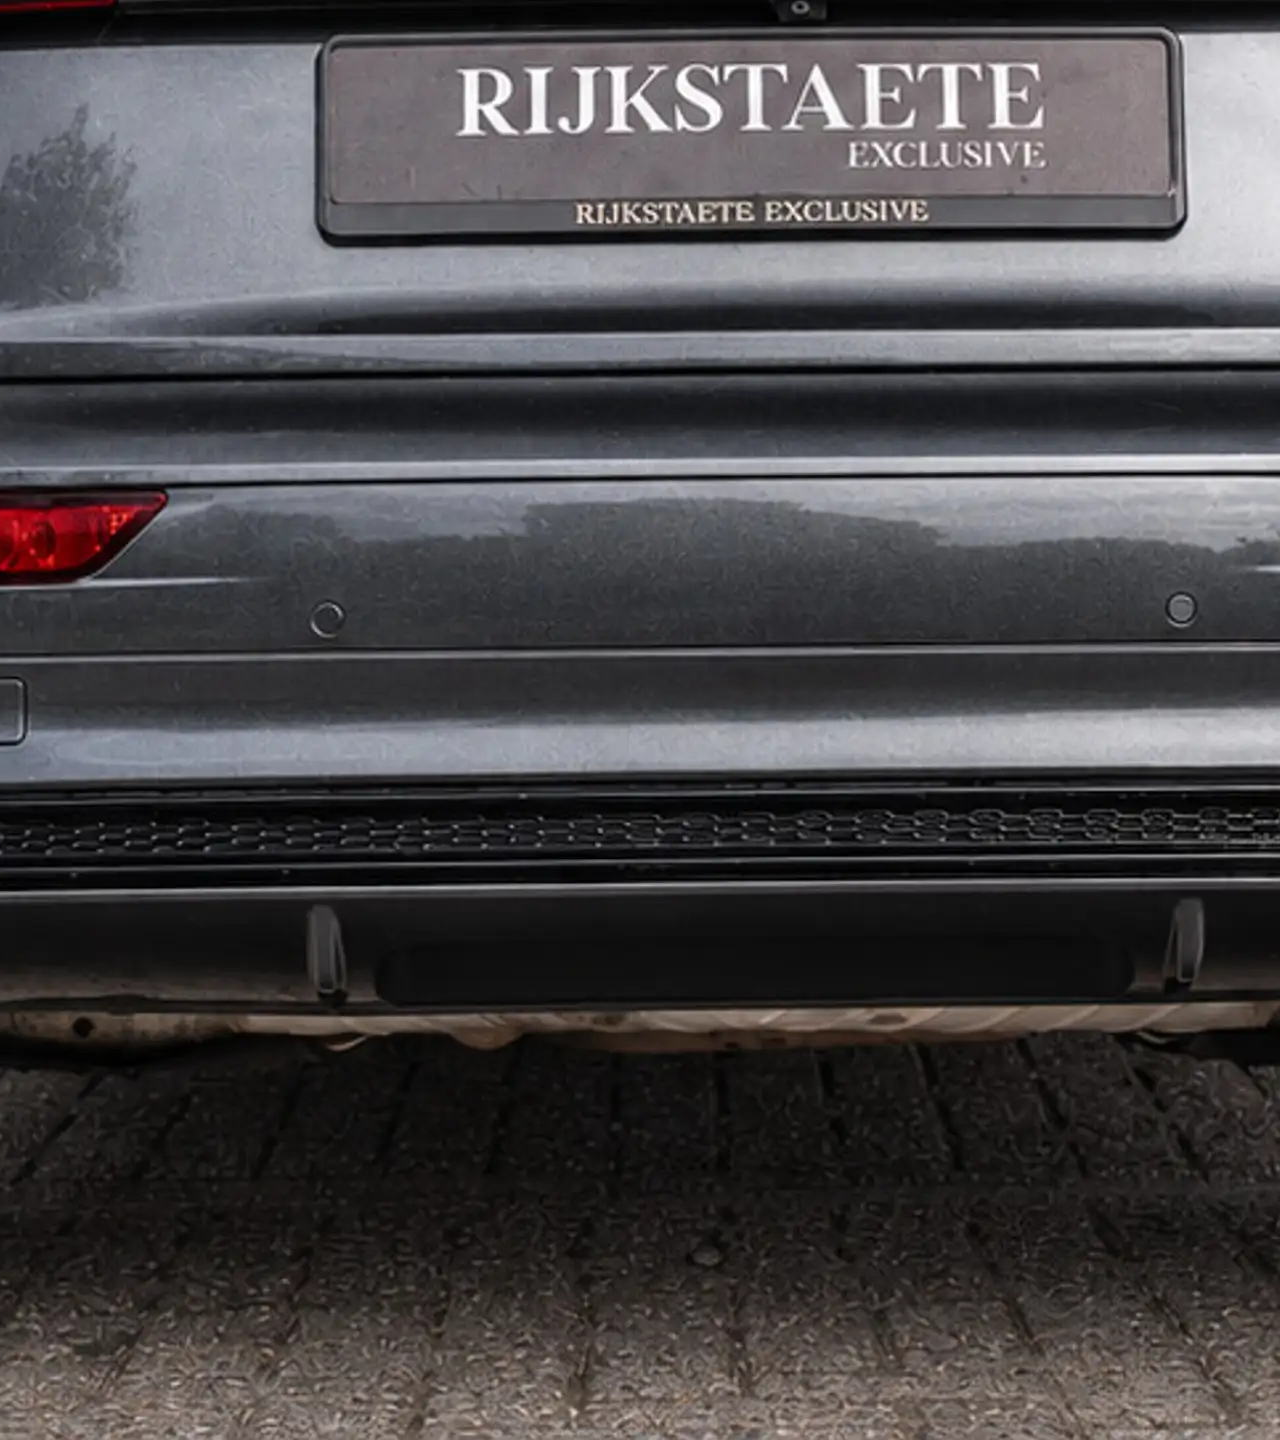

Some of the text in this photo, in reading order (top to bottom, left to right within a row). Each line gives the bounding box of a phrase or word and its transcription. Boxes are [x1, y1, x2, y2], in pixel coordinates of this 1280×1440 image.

[456, 63, 1046, 137] RIJKSTAETE
[846, 140, 1046, 169] EXCLUSIVE
[574, 199, 929, 225] RIJKSTAETE EXCLUSIVE
